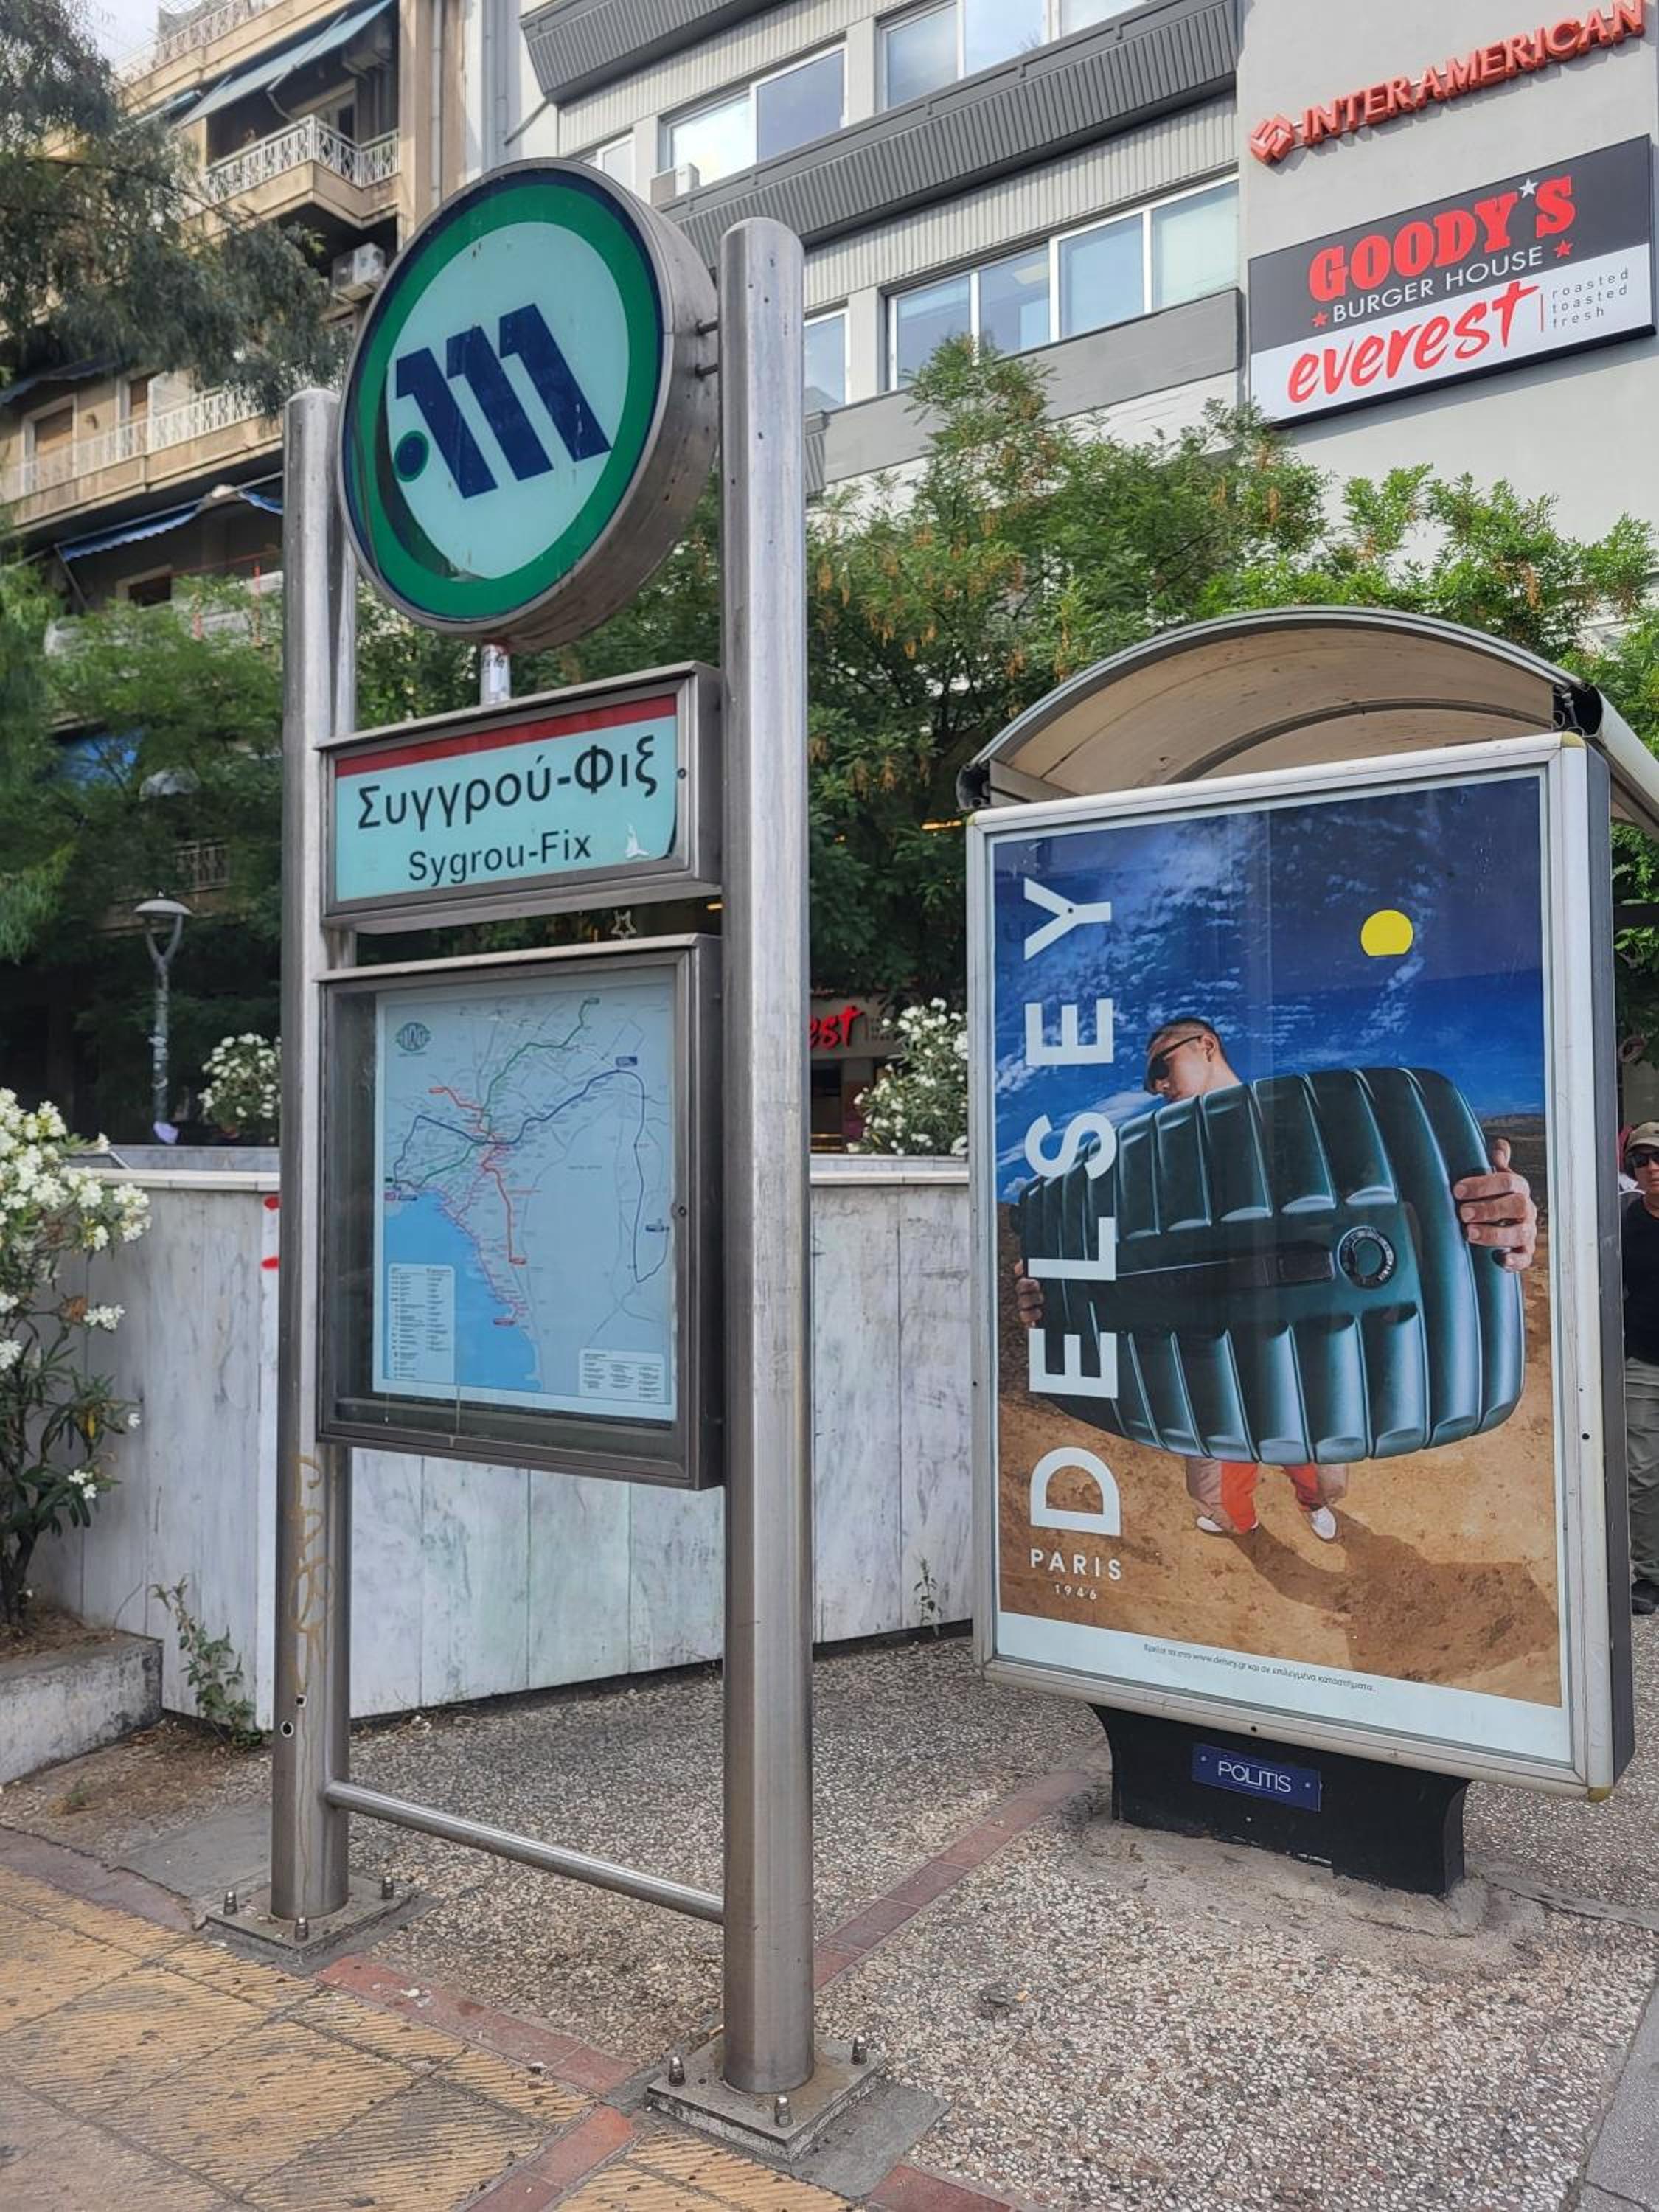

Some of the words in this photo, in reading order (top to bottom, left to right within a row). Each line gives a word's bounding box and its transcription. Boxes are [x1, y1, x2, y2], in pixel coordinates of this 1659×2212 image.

[1301, 0, 1647, 142] INTERAMERICAN
[1332, 279, 1434, 323] BURGER
[1445, 246, 1543, 291] HOUSE
[1552, 268, 1628, 299] roasted
[1552, 284, 1627, 313] toasted
[1553, 306, 1602, 328] fresh
[1287, 281, 1540, 403] everest
[358, 735, 658, 831] Συγγρού-Φιξ
[408, 829, 591, 886] Sygrou-Fix
[1023, 877, 1121, 1537] DELSEY
[1031, 1548, 1122, 1582] PARIS
[1054, 1583, 1098, 1601] 1946
[1217, 1759, 1293, 1793] POLITIS
